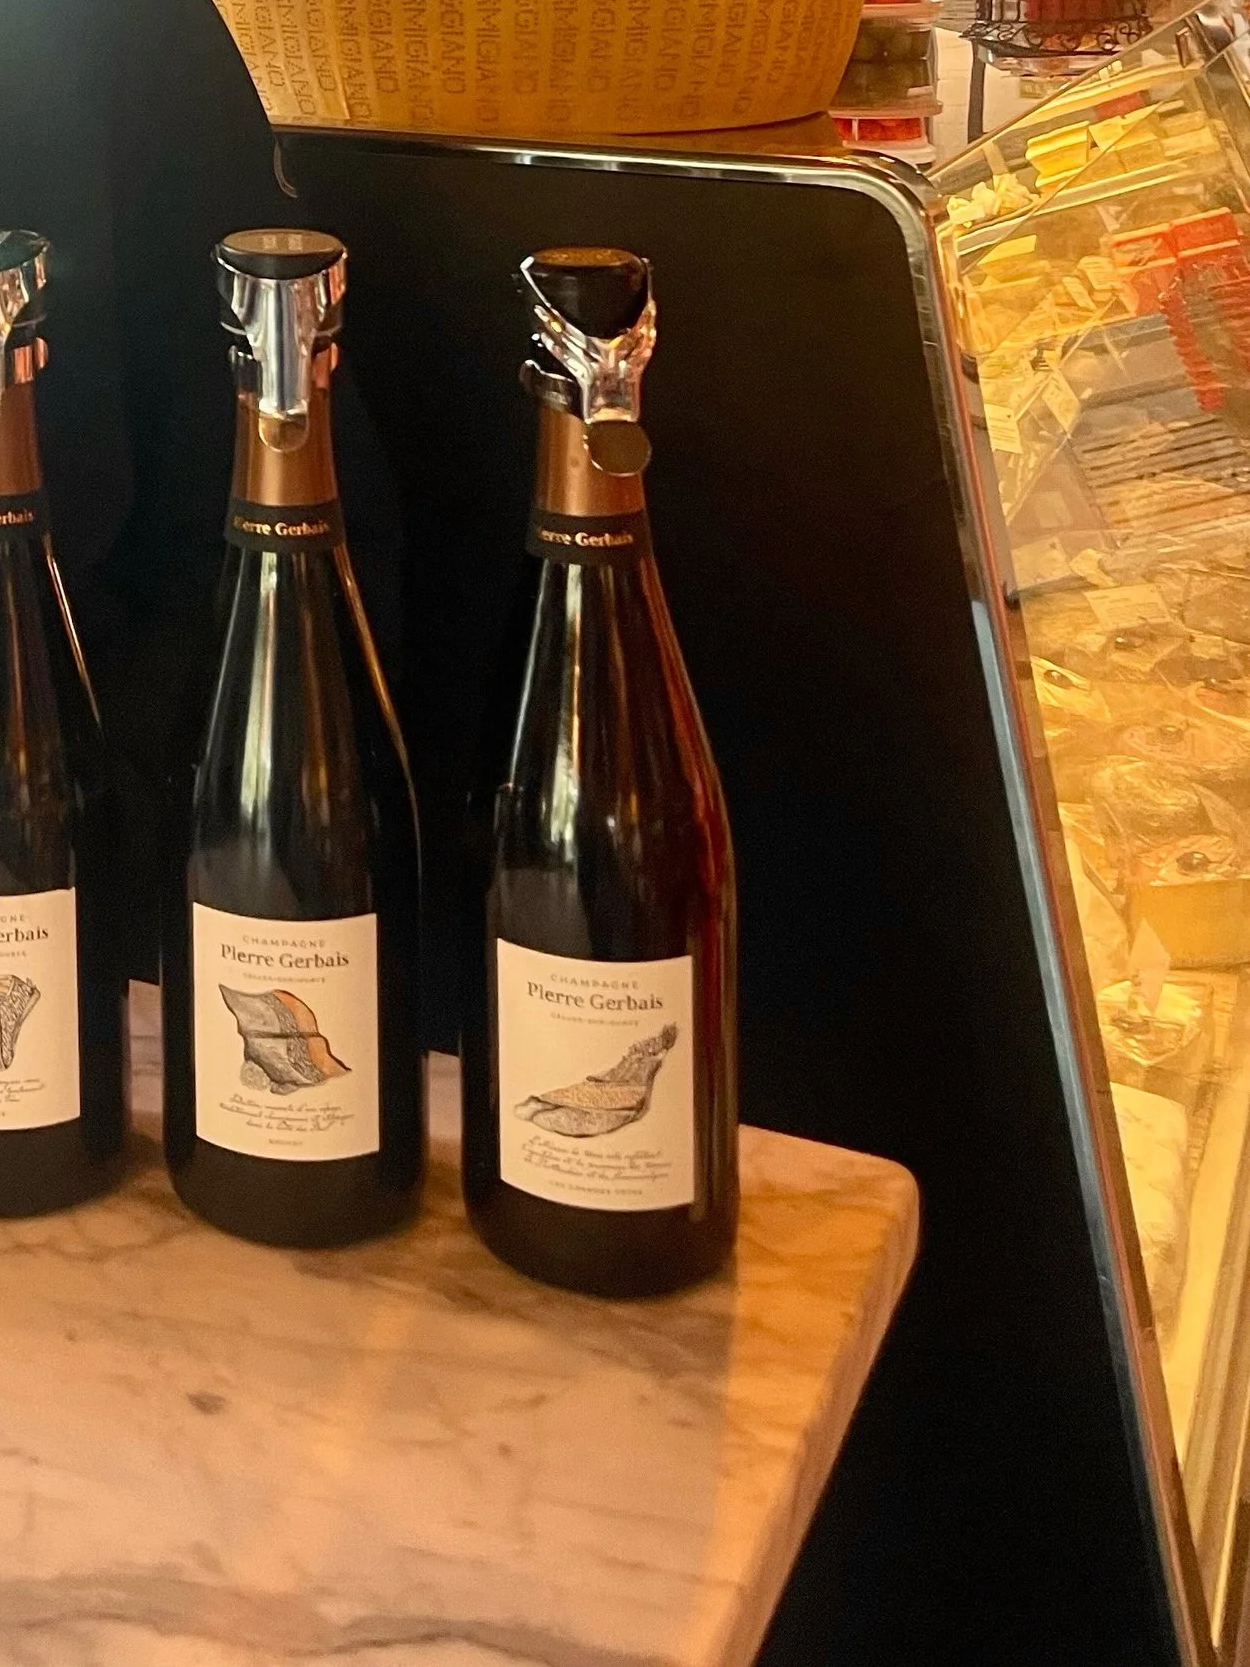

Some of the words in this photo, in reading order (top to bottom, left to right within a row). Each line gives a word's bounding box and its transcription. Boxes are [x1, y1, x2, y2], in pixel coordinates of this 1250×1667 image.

[242, 935, 327, 949] CHAMPAGNE
[220, 943, 275, 967] Pierre
[278, 950, 351, 969] Gerbais
[549, 973, 640, 990] CHAMPAGNE
[526, 980, 586, 1009] Pierre
[588, 992, 664, 1011] Gerbais
